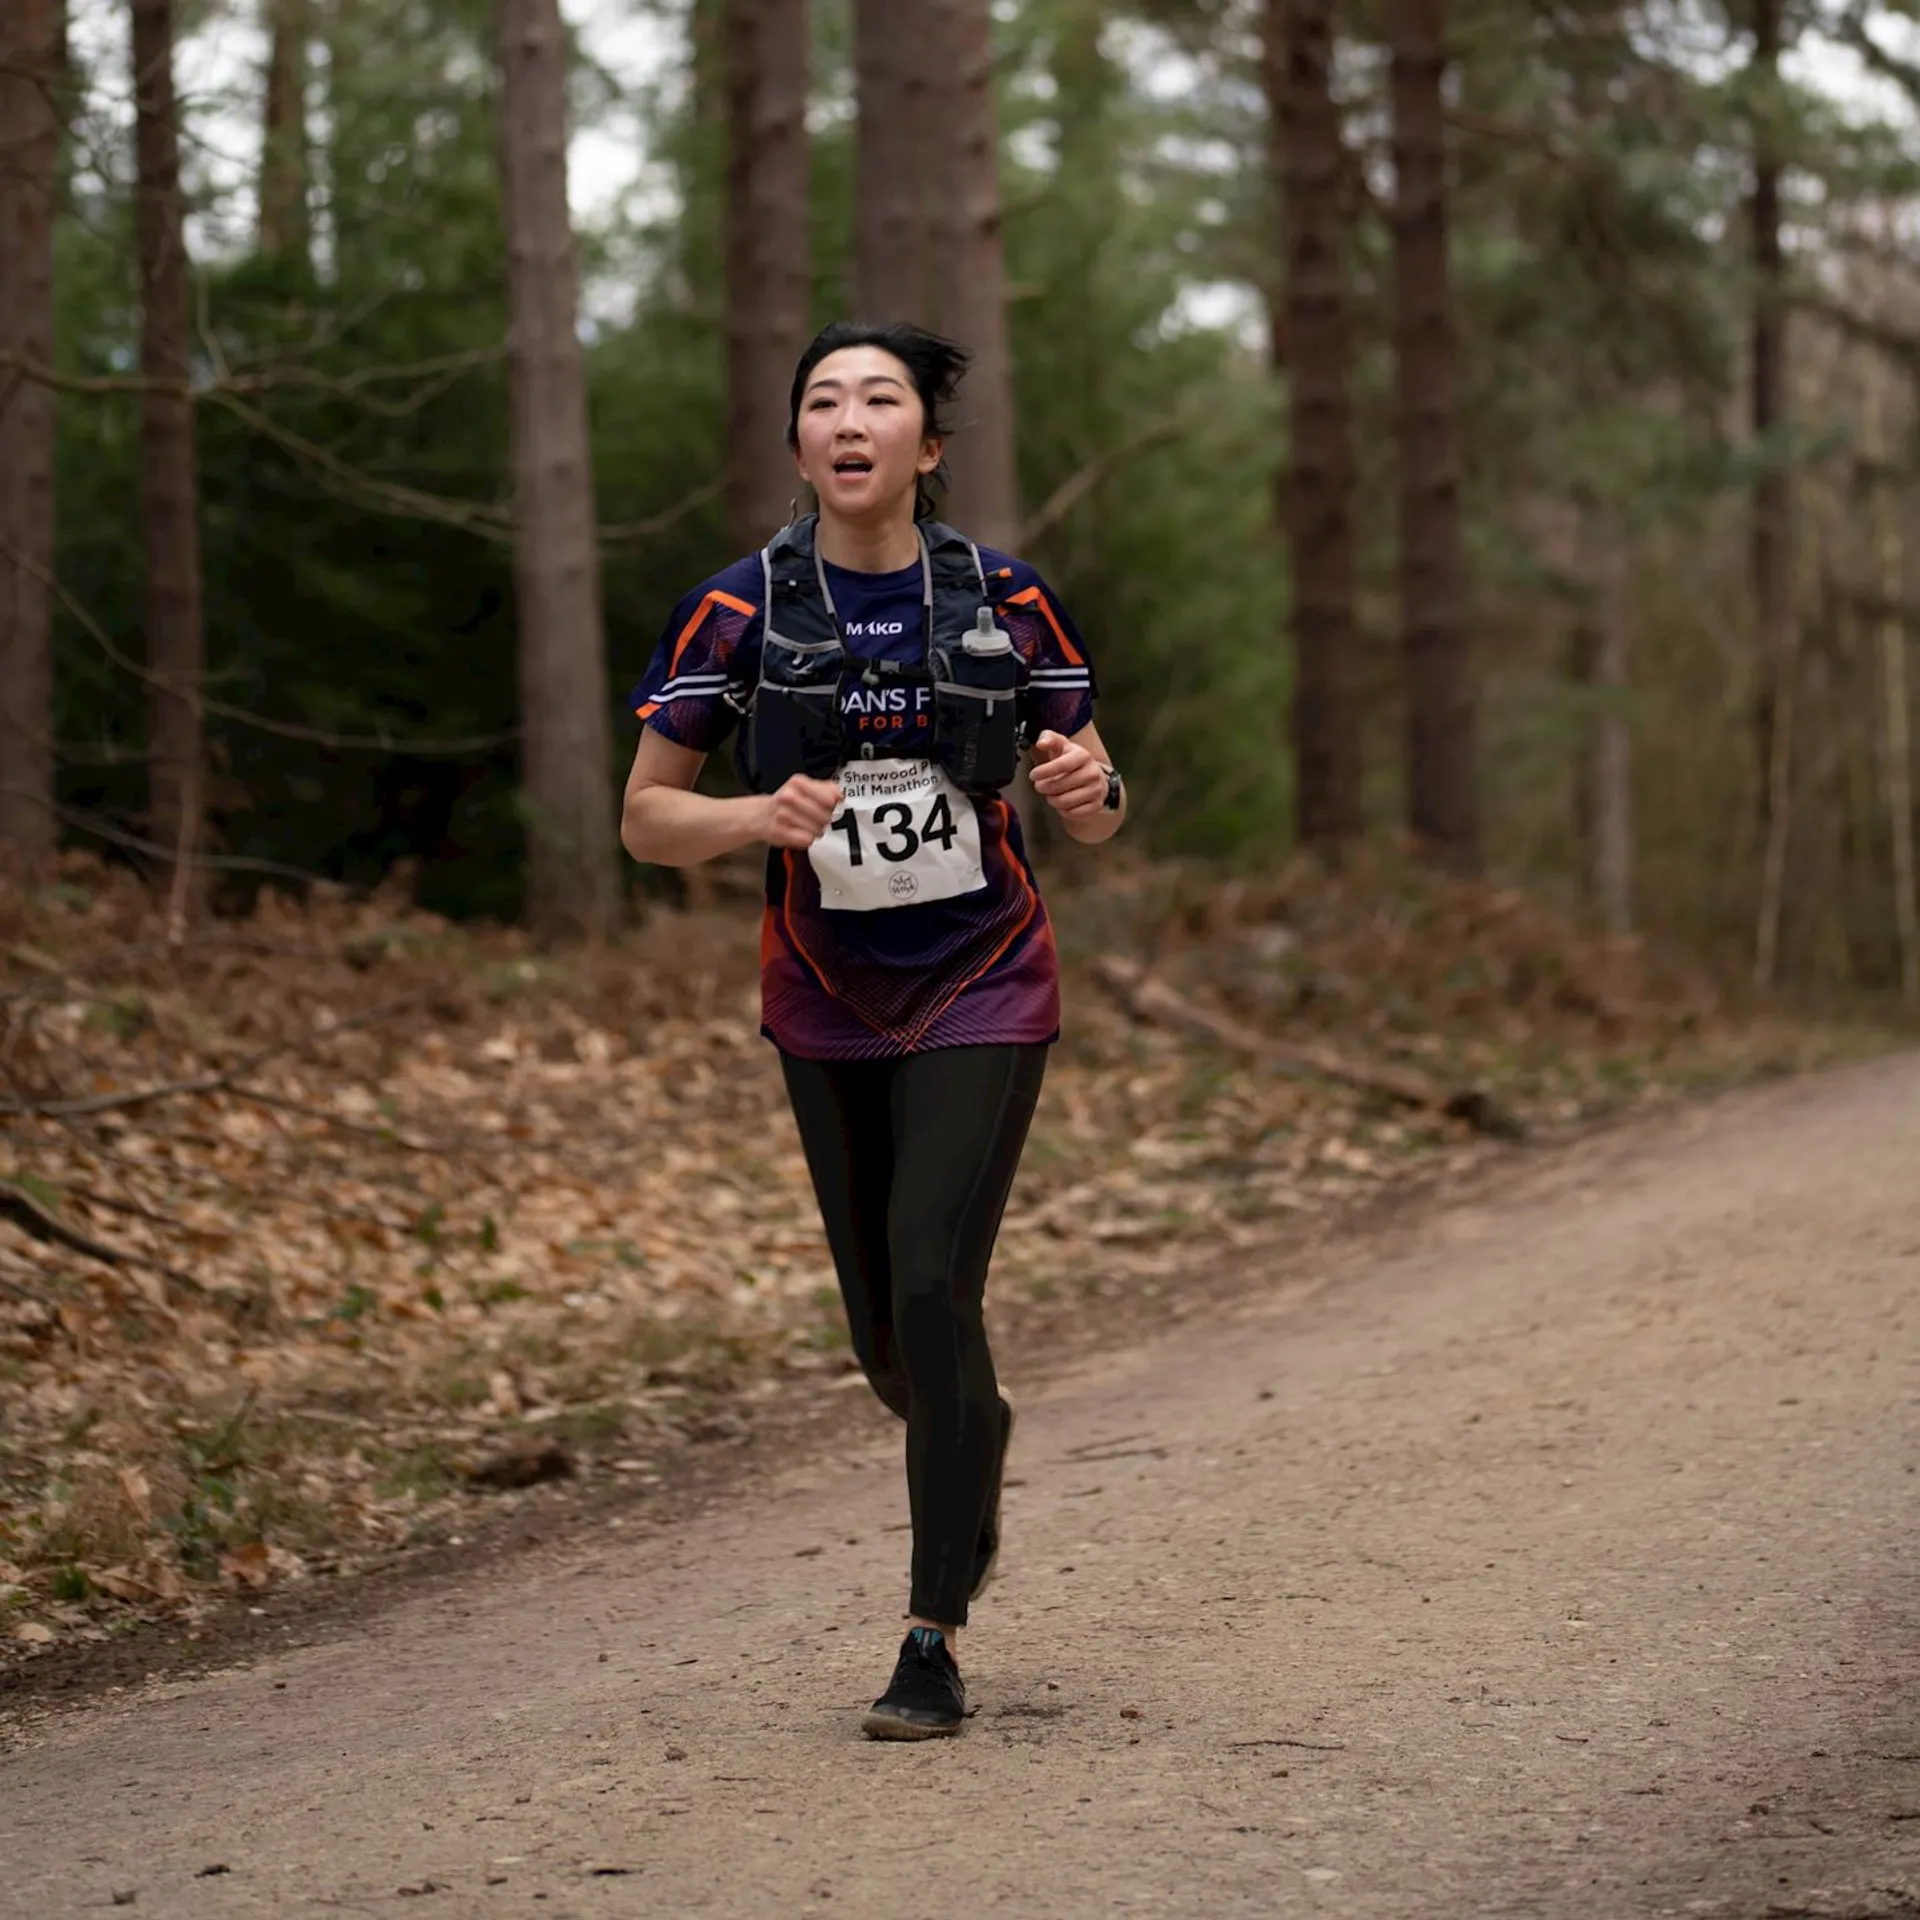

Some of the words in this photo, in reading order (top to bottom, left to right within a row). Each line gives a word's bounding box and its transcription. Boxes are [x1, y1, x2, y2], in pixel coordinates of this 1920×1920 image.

[840, 688, 907, 714] AN'S
[859, 715, 904, 731] FOR
[844, 763, 918, 784] Sherwood
[871, 775, 939, 796] Marathon
[831, 793, 958, 867] 134
